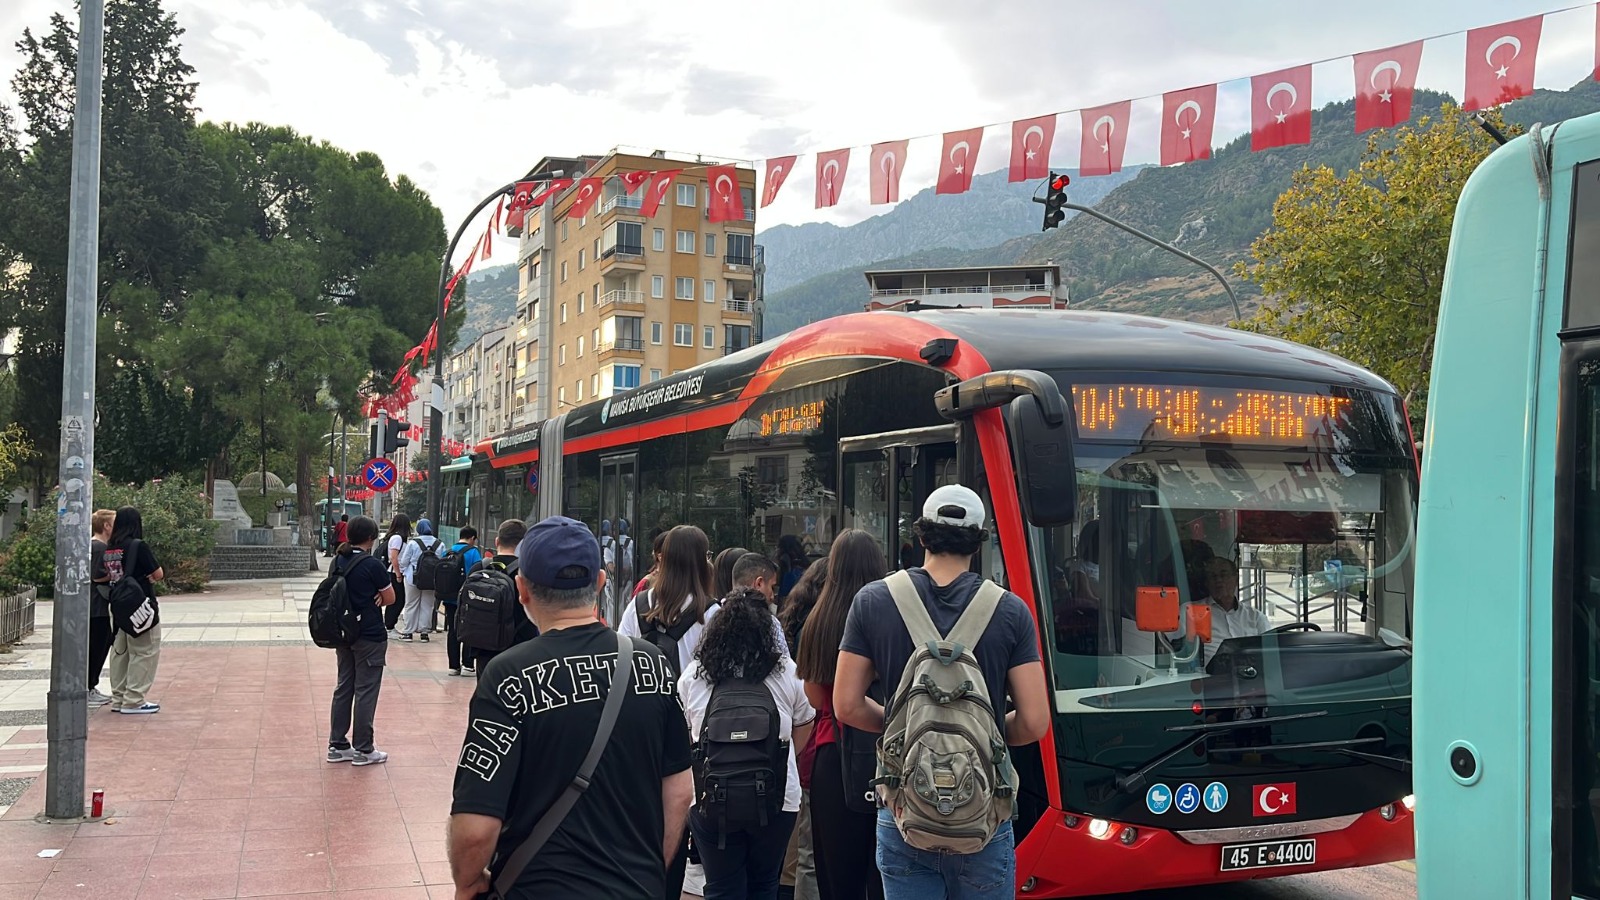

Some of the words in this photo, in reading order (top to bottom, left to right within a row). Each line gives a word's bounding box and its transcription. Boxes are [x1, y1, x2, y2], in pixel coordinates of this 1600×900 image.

[1230, 848, 1249, 867] 45
[1257, 846, 1267, 864] E
[1276, 843, 1313, 863] 4400
